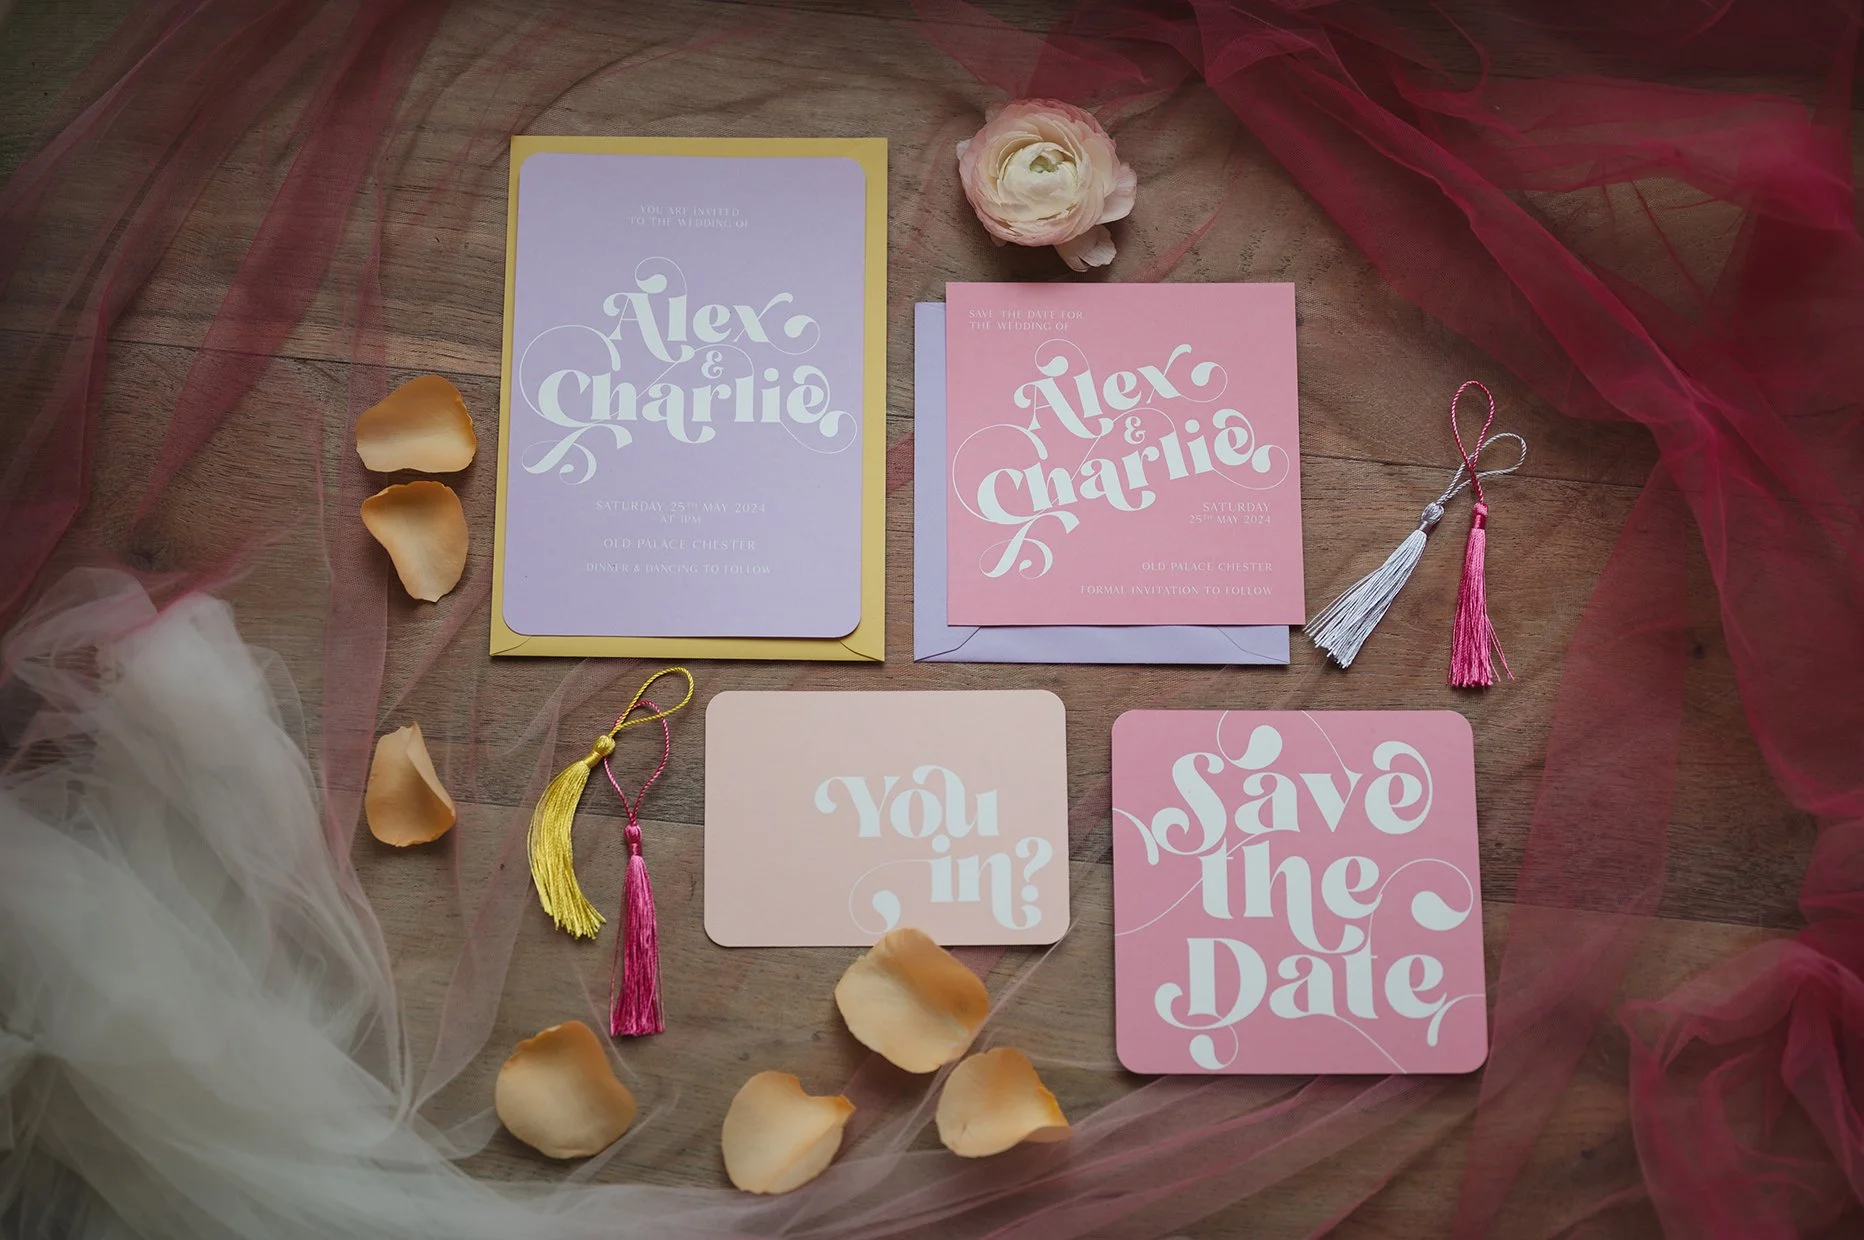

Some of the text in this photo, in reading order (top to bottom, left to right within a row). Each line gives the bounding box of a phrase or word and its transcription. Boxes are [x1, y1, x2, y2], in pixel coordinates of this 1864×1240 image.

[640, 204, 740, 216] YOU ARE INVITED
[630, 216, 749, 228] TO THE WEDDING OF
[603, 262, 815, 363] Alex
[968, 309, 1084, 320] SAVE THE DATE FOR
[969, 321, 1070, 331] THE WEDDING OF
[701, 350, 724, 379] &
[1014, 342, 1222, 439] Alex
[522, 350, 857, 470] Charlie
[1124, 416, 1147, 445] &
[957, 409, 1289, 548] Charlie
[595, 501, 664, 511] SATURDAY
[703, 502, 728, 512] MAY
[735, 503, 766, 513] 2024
[1203, 502, 1270, 512] SATURDAY
[660, 515, 674, 524] AT
[1217, 515, 1239, 524] MAY
[1244, 515, 1271, 524] 2024
[603, 538, 757, 550] OLD PALACE CHESTER
[586, 562, 771, 574] DINNER & DANCING TO FOLLOW
[1142, 562, 1273, 572] OLD PALACE CHESTER
[1080, 585, 1272, 595] FORMAL INVITATION TO FOLLOW
[1150, 728, 1434, 857] Save
[814, 764, 1000, 839] You
[890, 834, 1053, 931] in?
[1190, 836, 1425, 954] the
[1154, 938, 1452, 1055] Date
